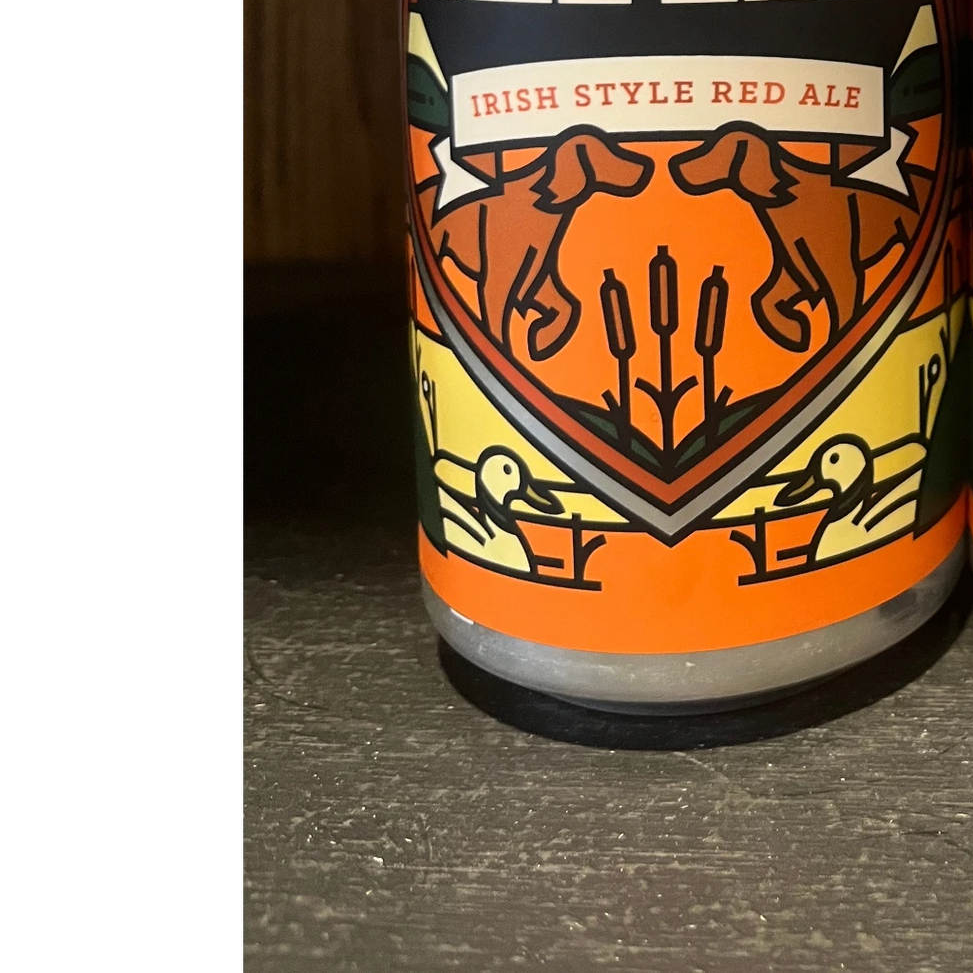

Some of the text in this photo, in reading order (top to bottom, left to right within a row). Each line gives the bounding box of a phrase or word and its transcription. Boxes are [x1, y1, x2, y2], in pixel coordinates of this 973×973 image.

[470, 81, 863, 118] IRISH STYLE RED ALE
